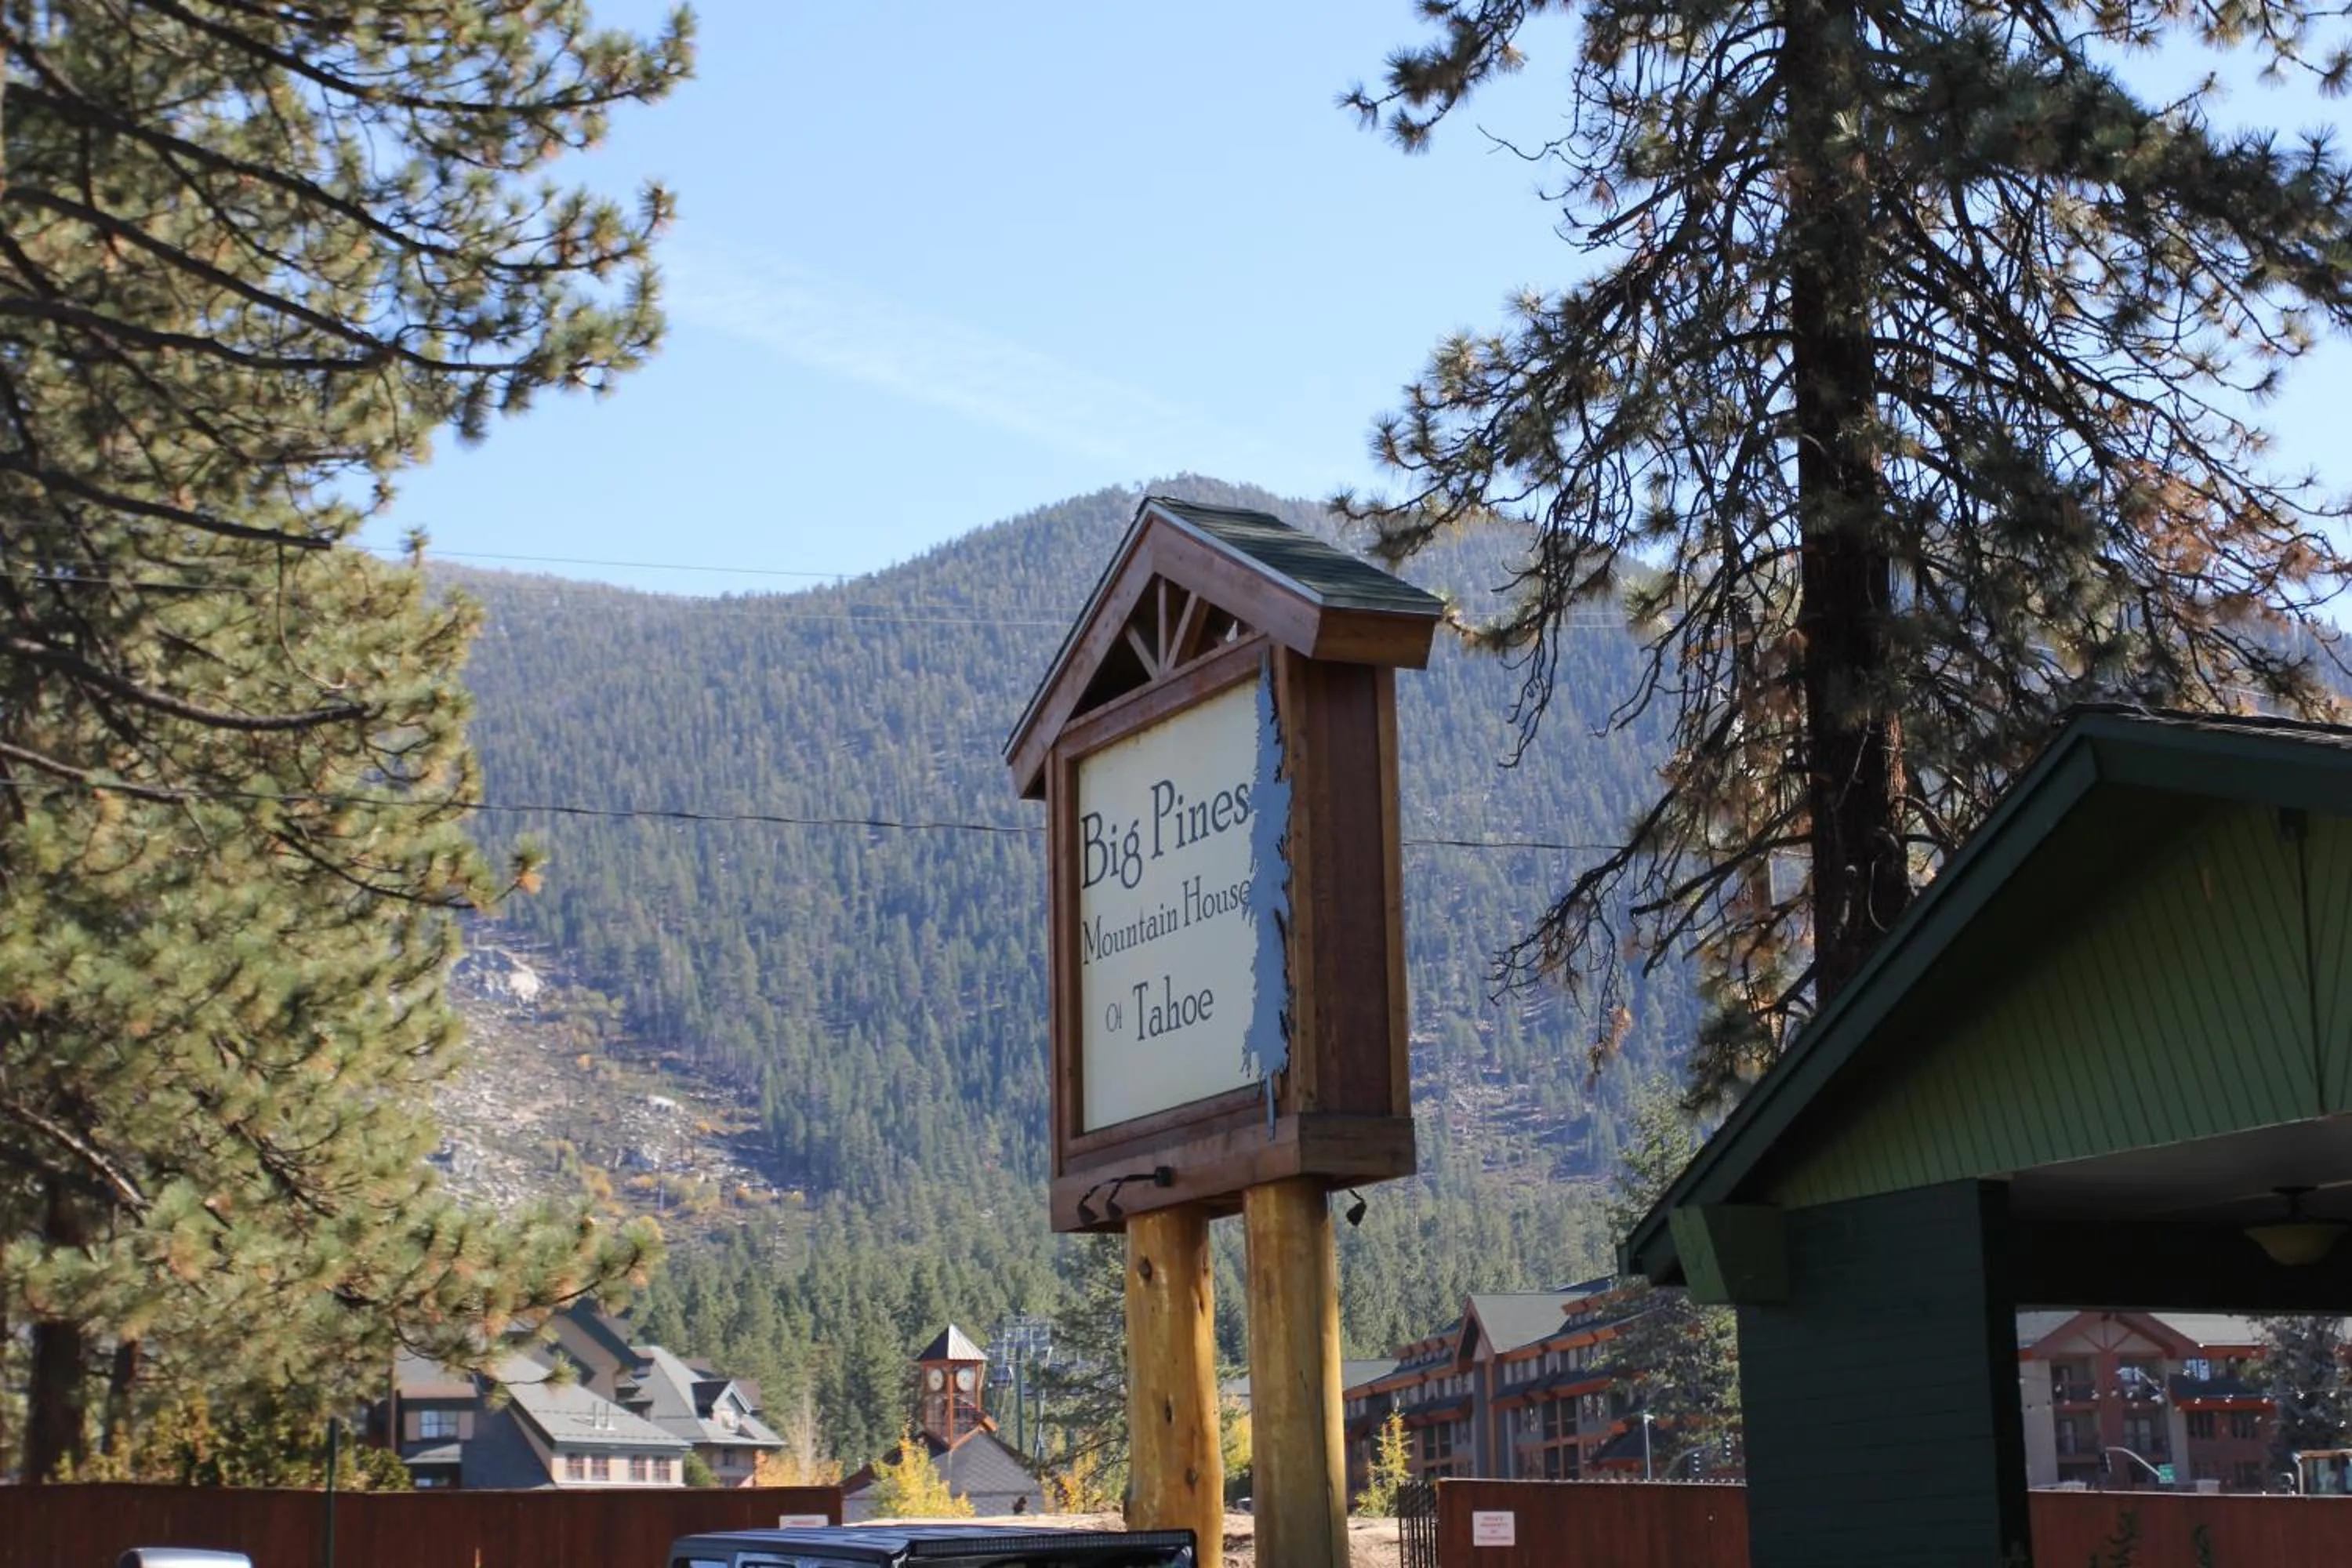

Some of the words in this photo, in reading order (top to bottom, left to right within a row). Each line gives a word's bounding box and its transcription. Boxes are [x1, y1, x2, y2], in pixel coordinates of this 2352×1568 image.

[1081, 811, 1142, 889] Big
[1151, 780, 1250, 860] Pines
[1082, 903, 1178, 965] Mountain
[1182, 874, 1252, 927] House
[1132, 975, 1214, 1042] Tahoe
